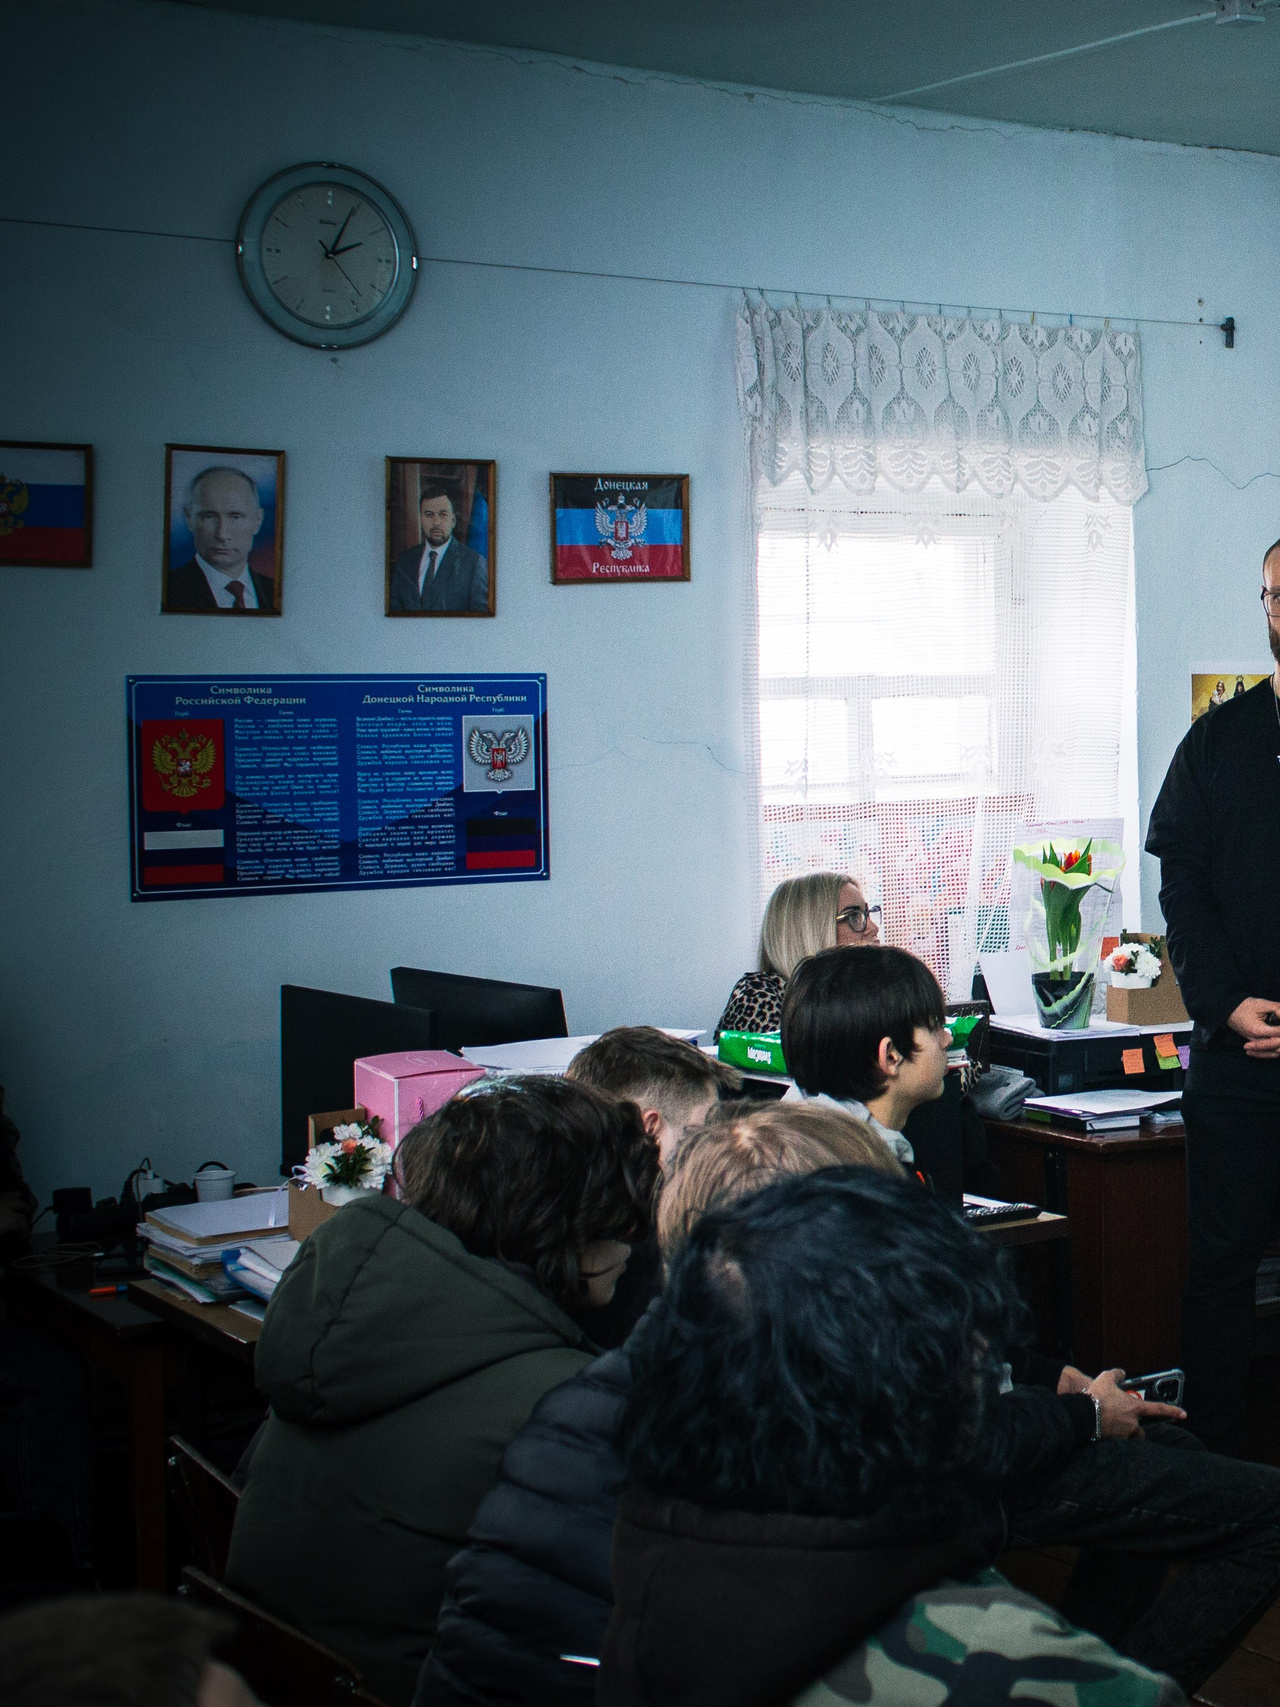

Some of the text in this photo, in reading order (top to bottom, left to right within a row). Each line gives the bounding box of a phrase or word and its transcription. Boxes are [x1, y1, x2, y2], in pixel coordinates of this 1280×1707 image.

[594, 478, 648, 492] Донецкая
[592, 562, 650, 576] Республика
[210, 686, 273, 695] Символика
[417, 684, 474, 693] Символика
[175, 695, 306, 706] Российской Федерации
[362, 693, 527, 704] Донецкой Народной Республики
